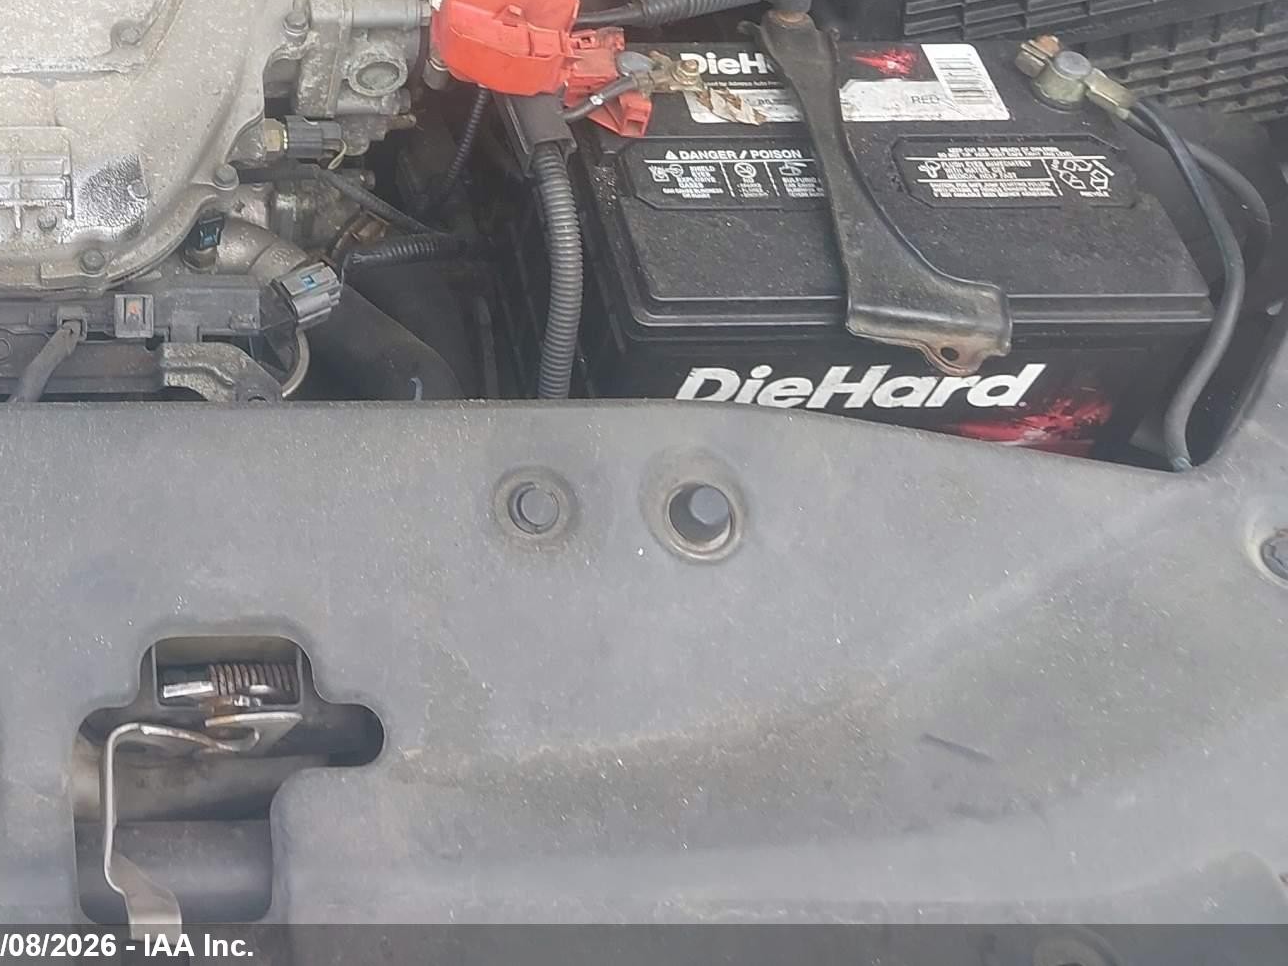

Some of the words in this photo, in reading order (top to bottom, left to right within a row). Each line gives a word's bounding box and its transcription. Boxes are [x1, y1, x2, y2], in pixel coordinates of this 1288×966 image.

[679, 51, 774, 75] DieH
[911, 95, 941, 105] RED
[679, 149, 738, 160] DANGER
[749, 149, 803, 159] POISON
[675, 363, 1046, 409] DieHard
